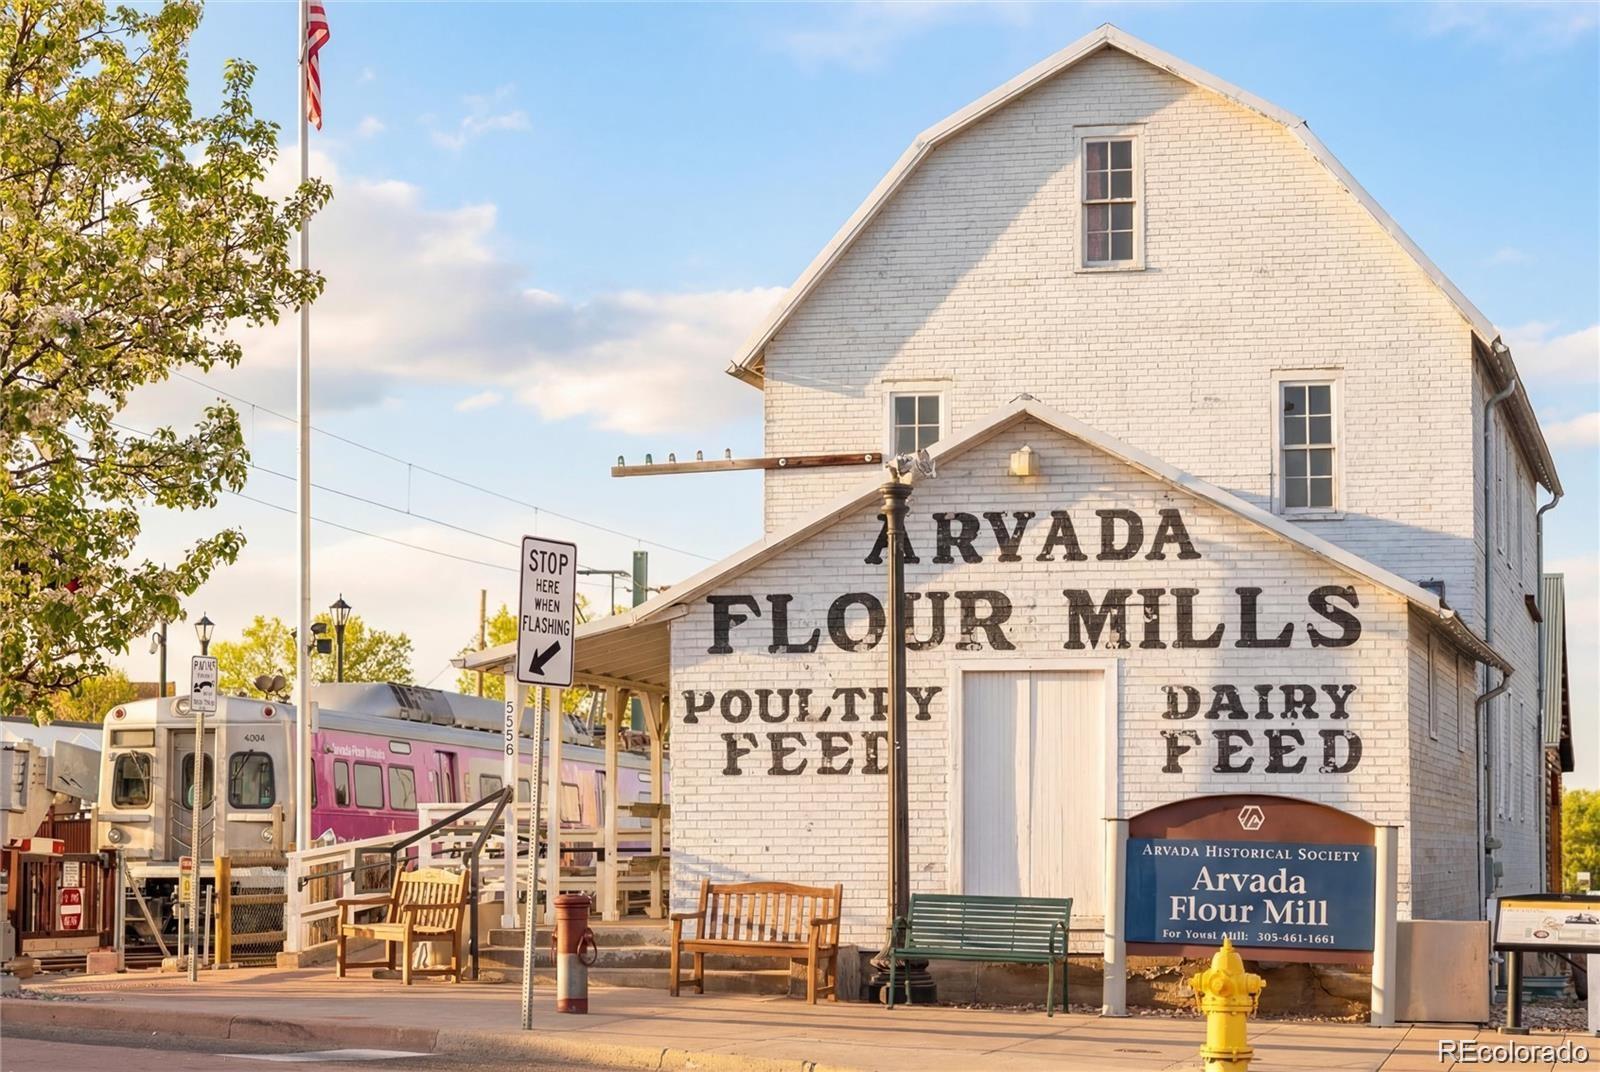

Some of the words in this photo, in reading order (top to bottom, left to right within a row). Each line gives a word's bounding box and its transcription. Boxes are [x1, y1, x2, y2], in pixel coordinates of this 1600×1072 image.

[864, 508, 1202, 565] ARVADA
[528, 549, 569, 576] STOP
[535, 579, 560, 595] HERE
[534, 598, 560, 613] WHEN
[706, 590, 1016, 655] FLOUR
[1062, 585, 1362, 651] MILLS
[522, 615, 570, 637] FLASHING
[1160, 684, 1357, 720] DAIRY
[244, 734, 265, 742] 4004
[505, 701, 515, 757] 5556
[720, 731, 889, 776] FEED
[1159, 728, 1363, 774] FEED
[1142, 843, 1200, 857] ARVADA
[1205, 845, 1293, 860] HISTORICAL
[1298, 849, 1361, 863] SOCIETY
[1191, 866, 1307, 895] Arvada
[1169, 896, 1254, 924] Flour
[1263, 899, 1329, 926] Mill
[1162, 929, 1181, 939] For
